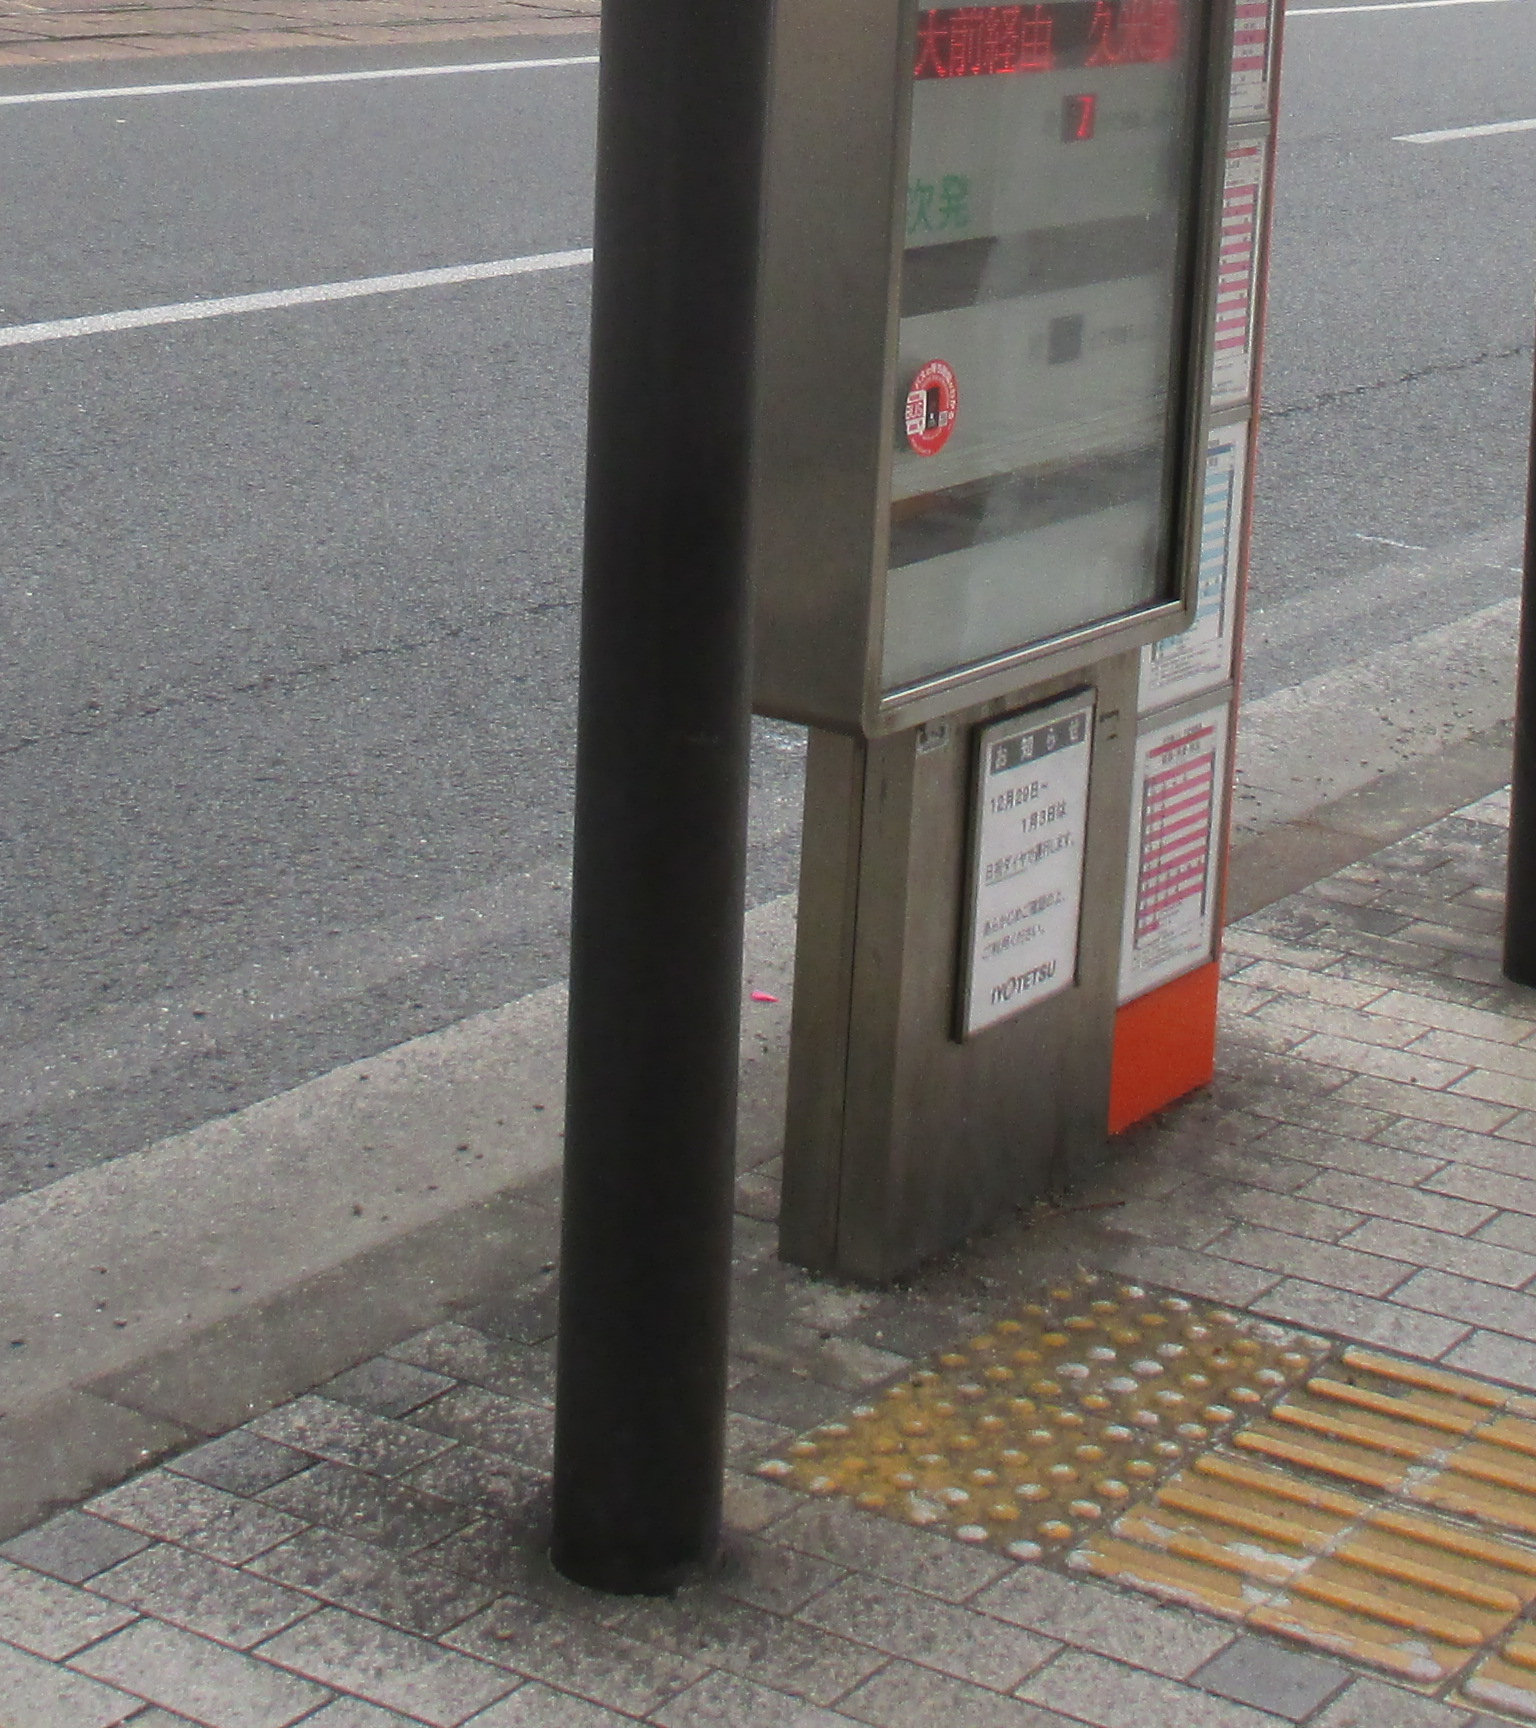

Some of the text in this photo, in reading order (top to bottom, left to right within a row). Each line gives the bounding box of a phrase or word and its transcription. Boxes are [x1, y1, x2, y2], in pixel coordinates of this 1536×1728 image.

[994, 717, 1081, 770] お知らせ
[990, 959, 1058, 1005] IYOTETSU
